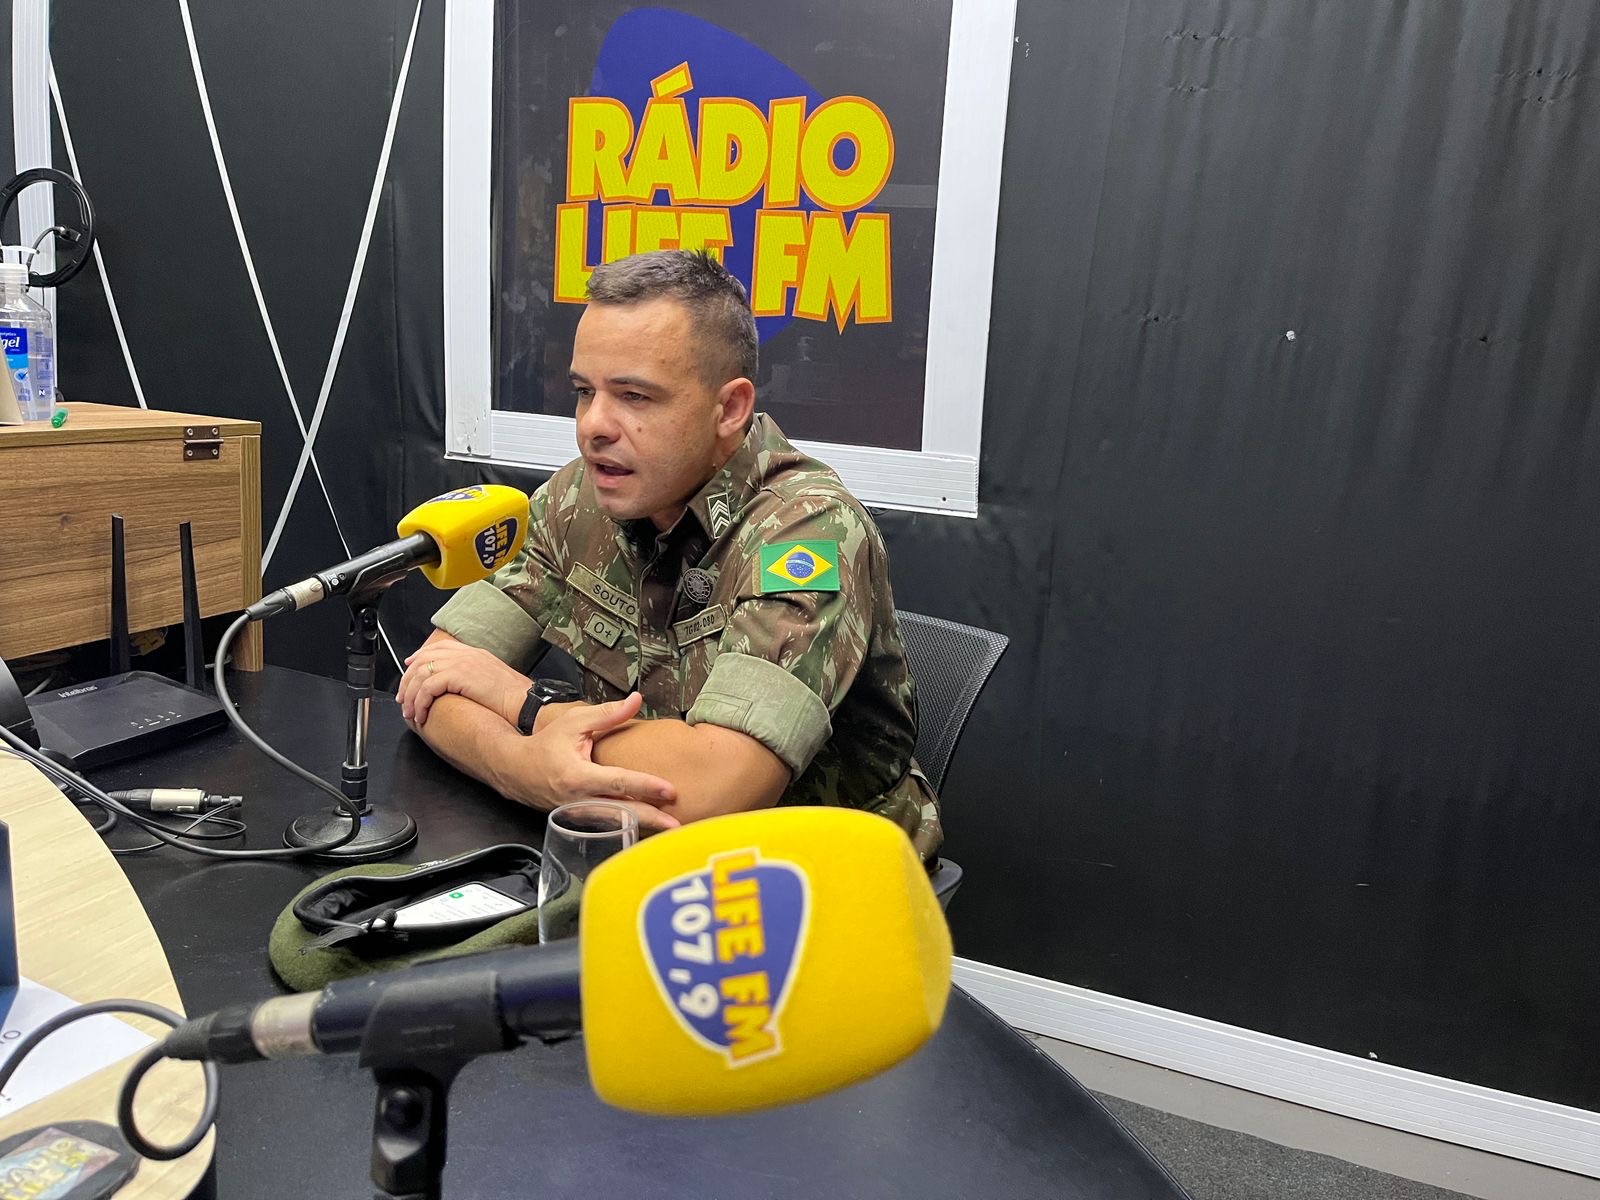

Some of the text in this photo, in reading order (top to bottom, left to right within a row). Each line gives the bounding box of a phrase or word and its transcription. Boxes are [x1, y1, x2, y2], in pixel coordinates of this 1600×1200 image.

[566, 61, 895, 212] RÁDIO
[751, 209, 893, 335] FM
[1, 336, 20, 350] gel
[592, 583, 637, 616] SOUTO
[668, 876, 720, 1019] 107,9
[711, 850, 778, 1062] LIFE FM
